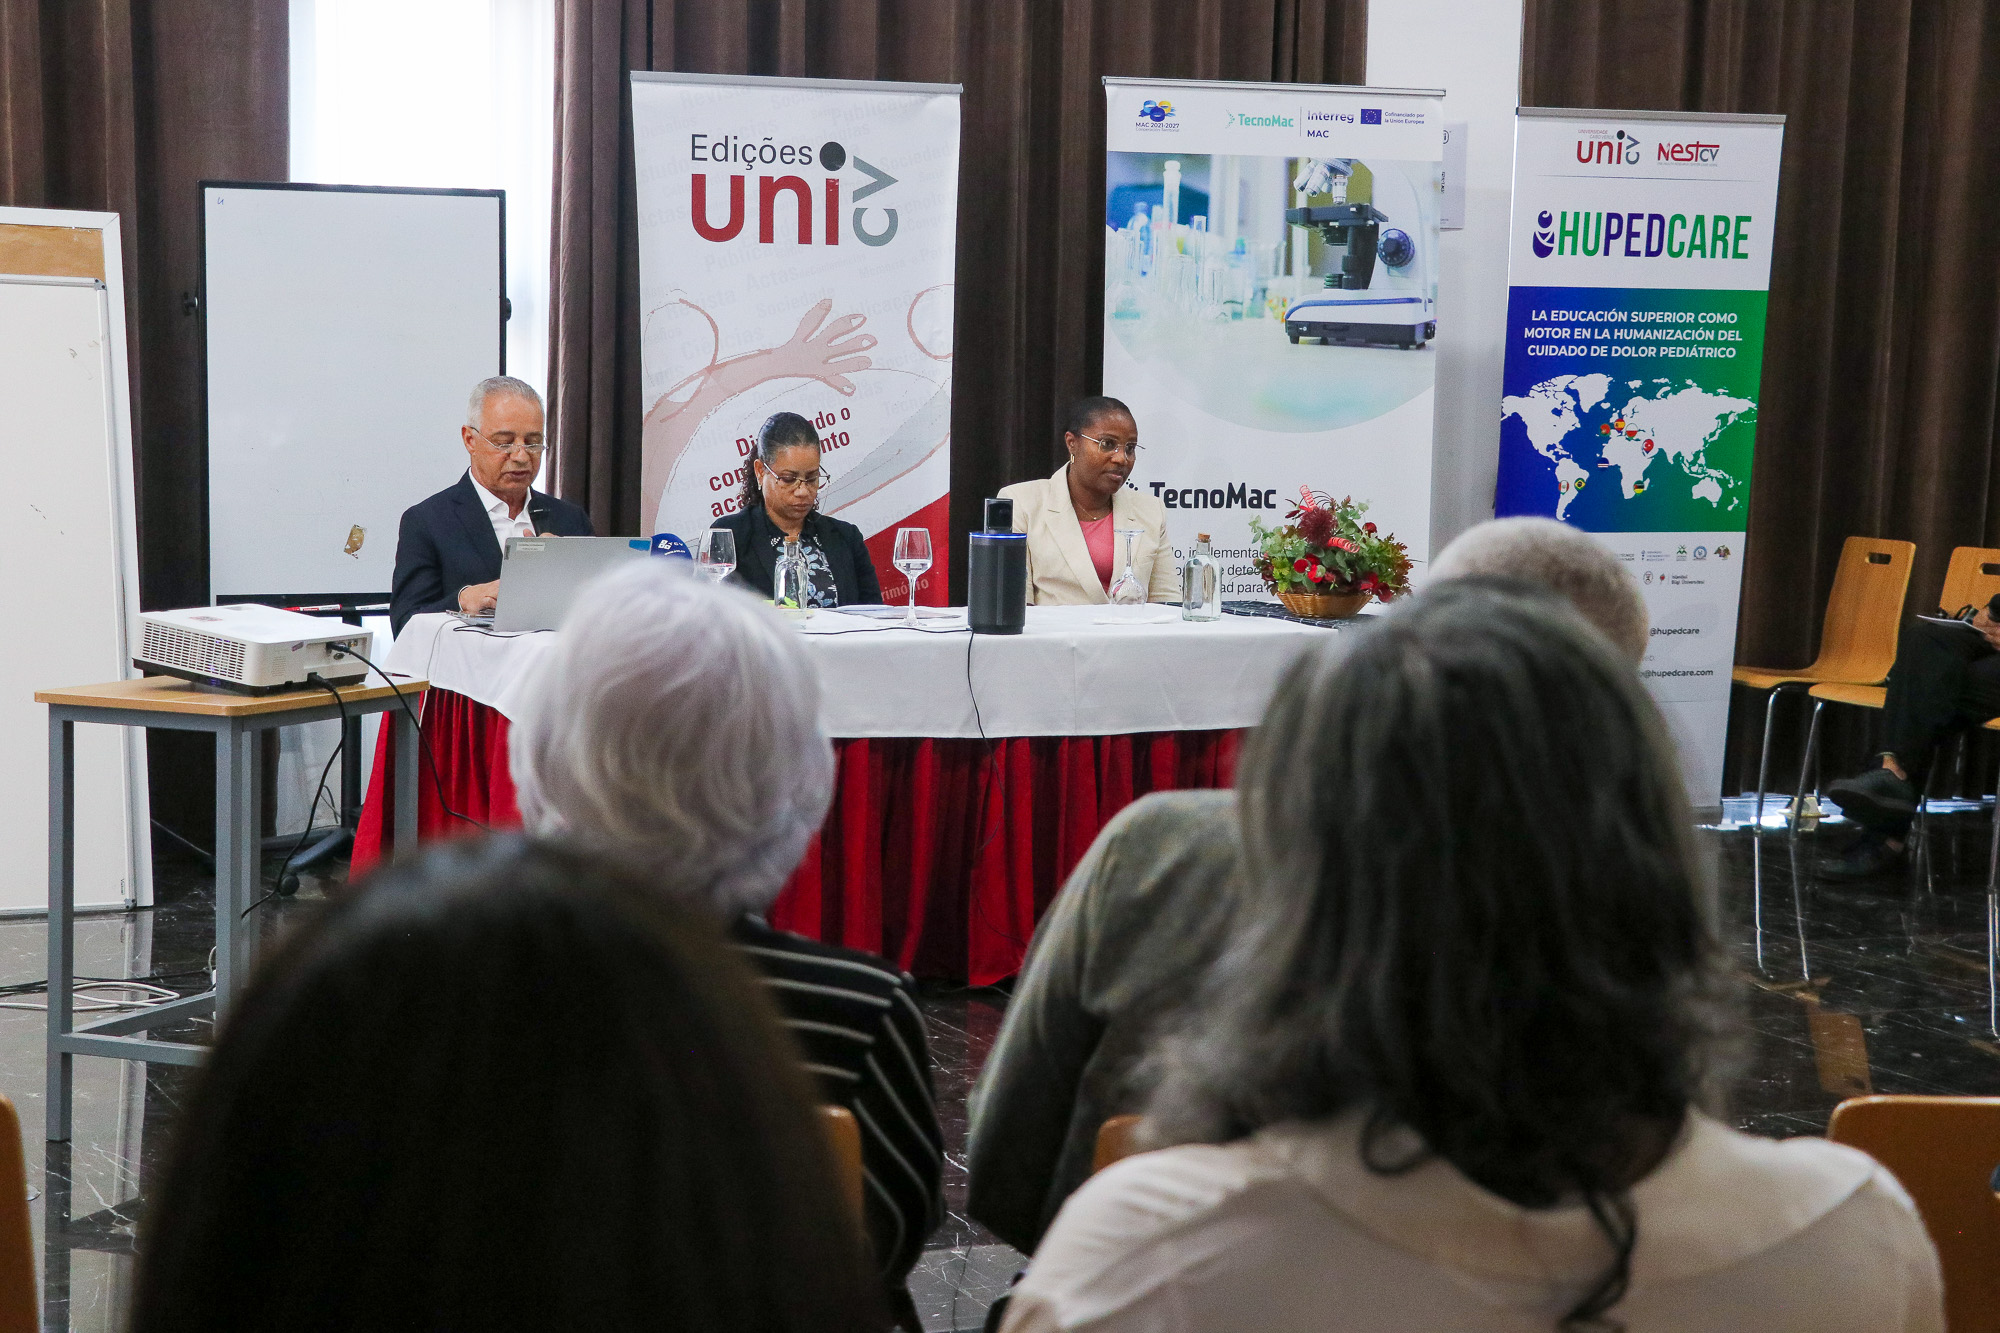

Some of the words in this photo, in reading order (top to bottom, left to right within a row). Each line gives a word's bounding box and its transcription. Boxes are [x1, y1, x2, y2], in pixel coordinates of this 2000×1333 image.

[1238, 113, 1294, 127] TecnoMac
[1307, 110, 1354, 123] Interreg
[1307, 130, 1329, 138] MAC
[691, 133, 813, 170] Edições
[691, 141, 846, 245] uni
[1557, 211, 1752, 259] HUPEDCARE
[1532, 310, 1547, 321] LA
[1550, 308, 1628, 323] EDUCACIÓN
[1631, 311, 1695, 323] SUPERIOR
[1697, 312, 1738, 324] COMO
[1524, 328, 1571, 339] MOTOR
[1574, 328, 1591, 339] EN
[1594, 328, 1611, 340] LA
[1614, 327, 1715, 341] HUMANIZACIÓN
[1717, 330, 1743, 341] DEL
[1527, 345, 1588, 357] CUIDADO
[1590, 346, 1608, 357] DE
[1611, 346, 1657, 357] DOLOR
[1659, 344, 1737, 358] PEDIÁTRICO
[840, 407, 851, 421] o
[1149, 481, 1277, 509] TecnoMac
[1237, 582, 1263, 594] para
[1650, 627, 1700, 637] @hupedcare
[1640, 669, 1714, 678] @hupedcare.com
